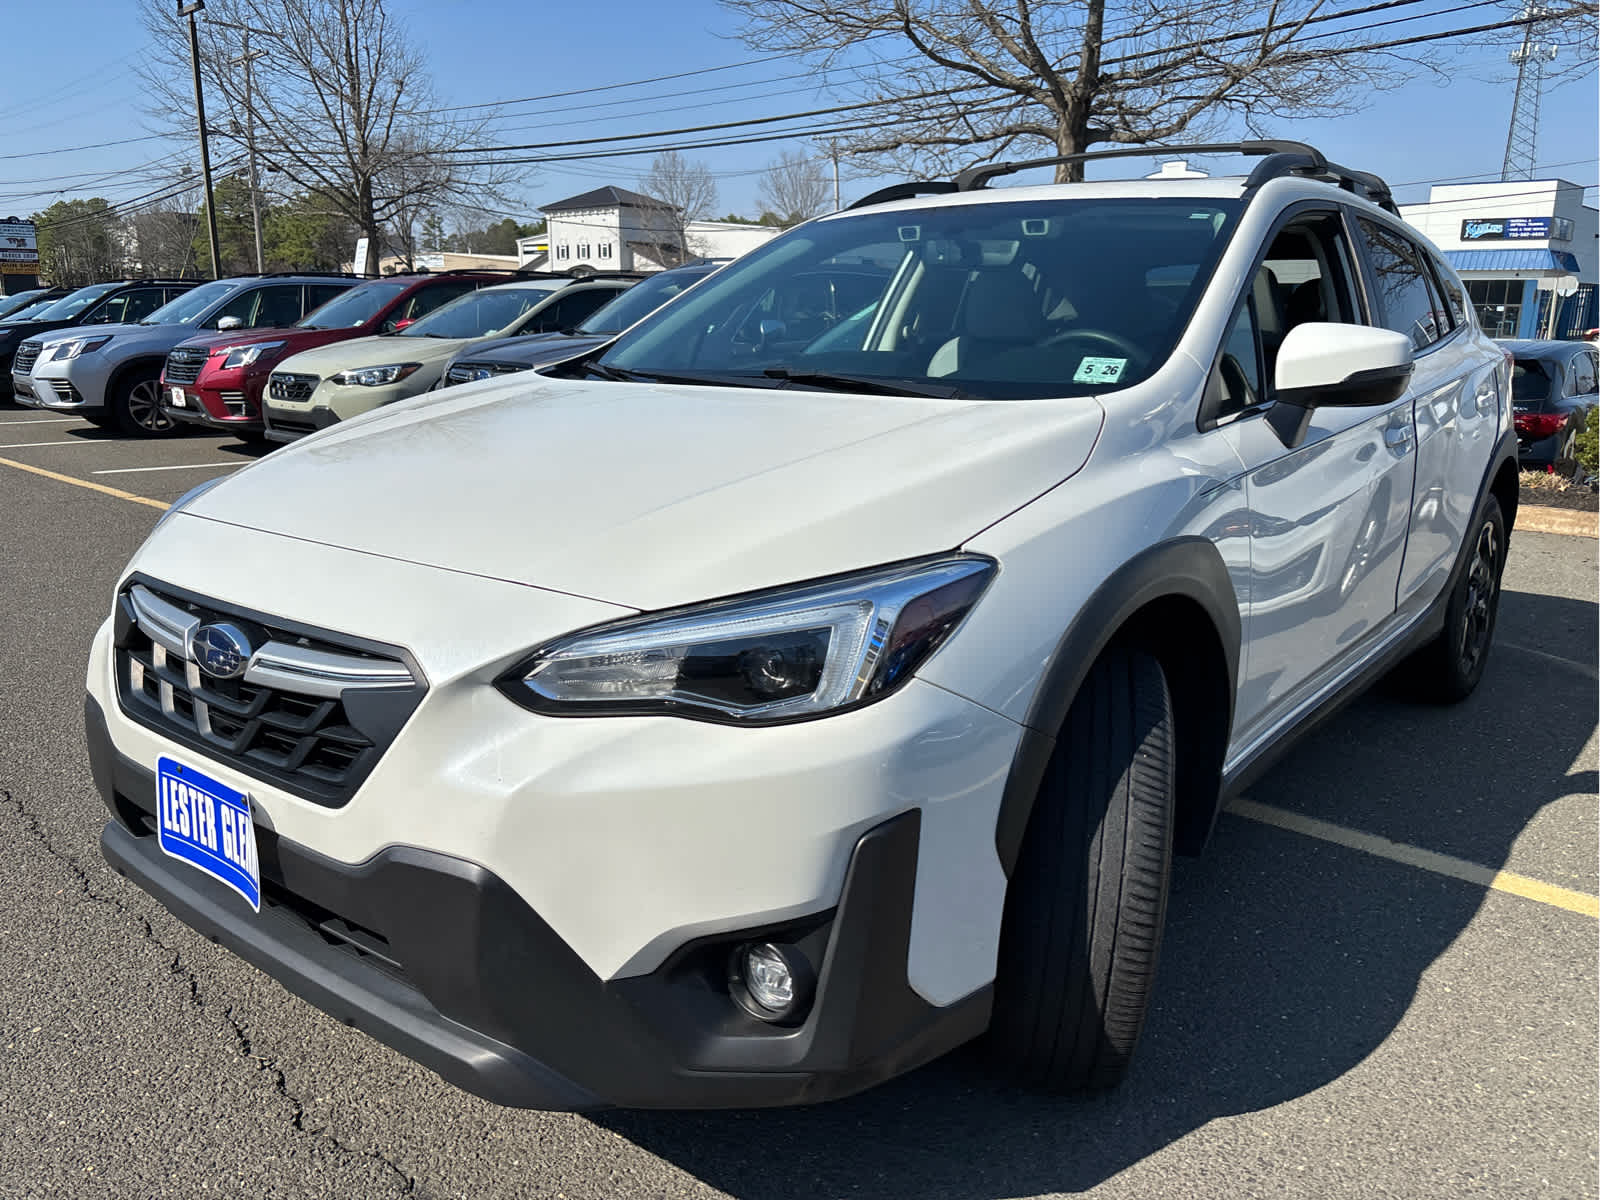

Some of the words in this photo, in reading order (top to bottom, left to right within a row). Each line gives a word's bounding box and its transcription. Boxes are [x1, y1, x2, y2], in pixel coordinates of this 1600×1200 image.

[1084, 364, 1095, 374] 5
[1101, 365, 1119, 375] 26
[161, 776, 217, 851] LESTER
